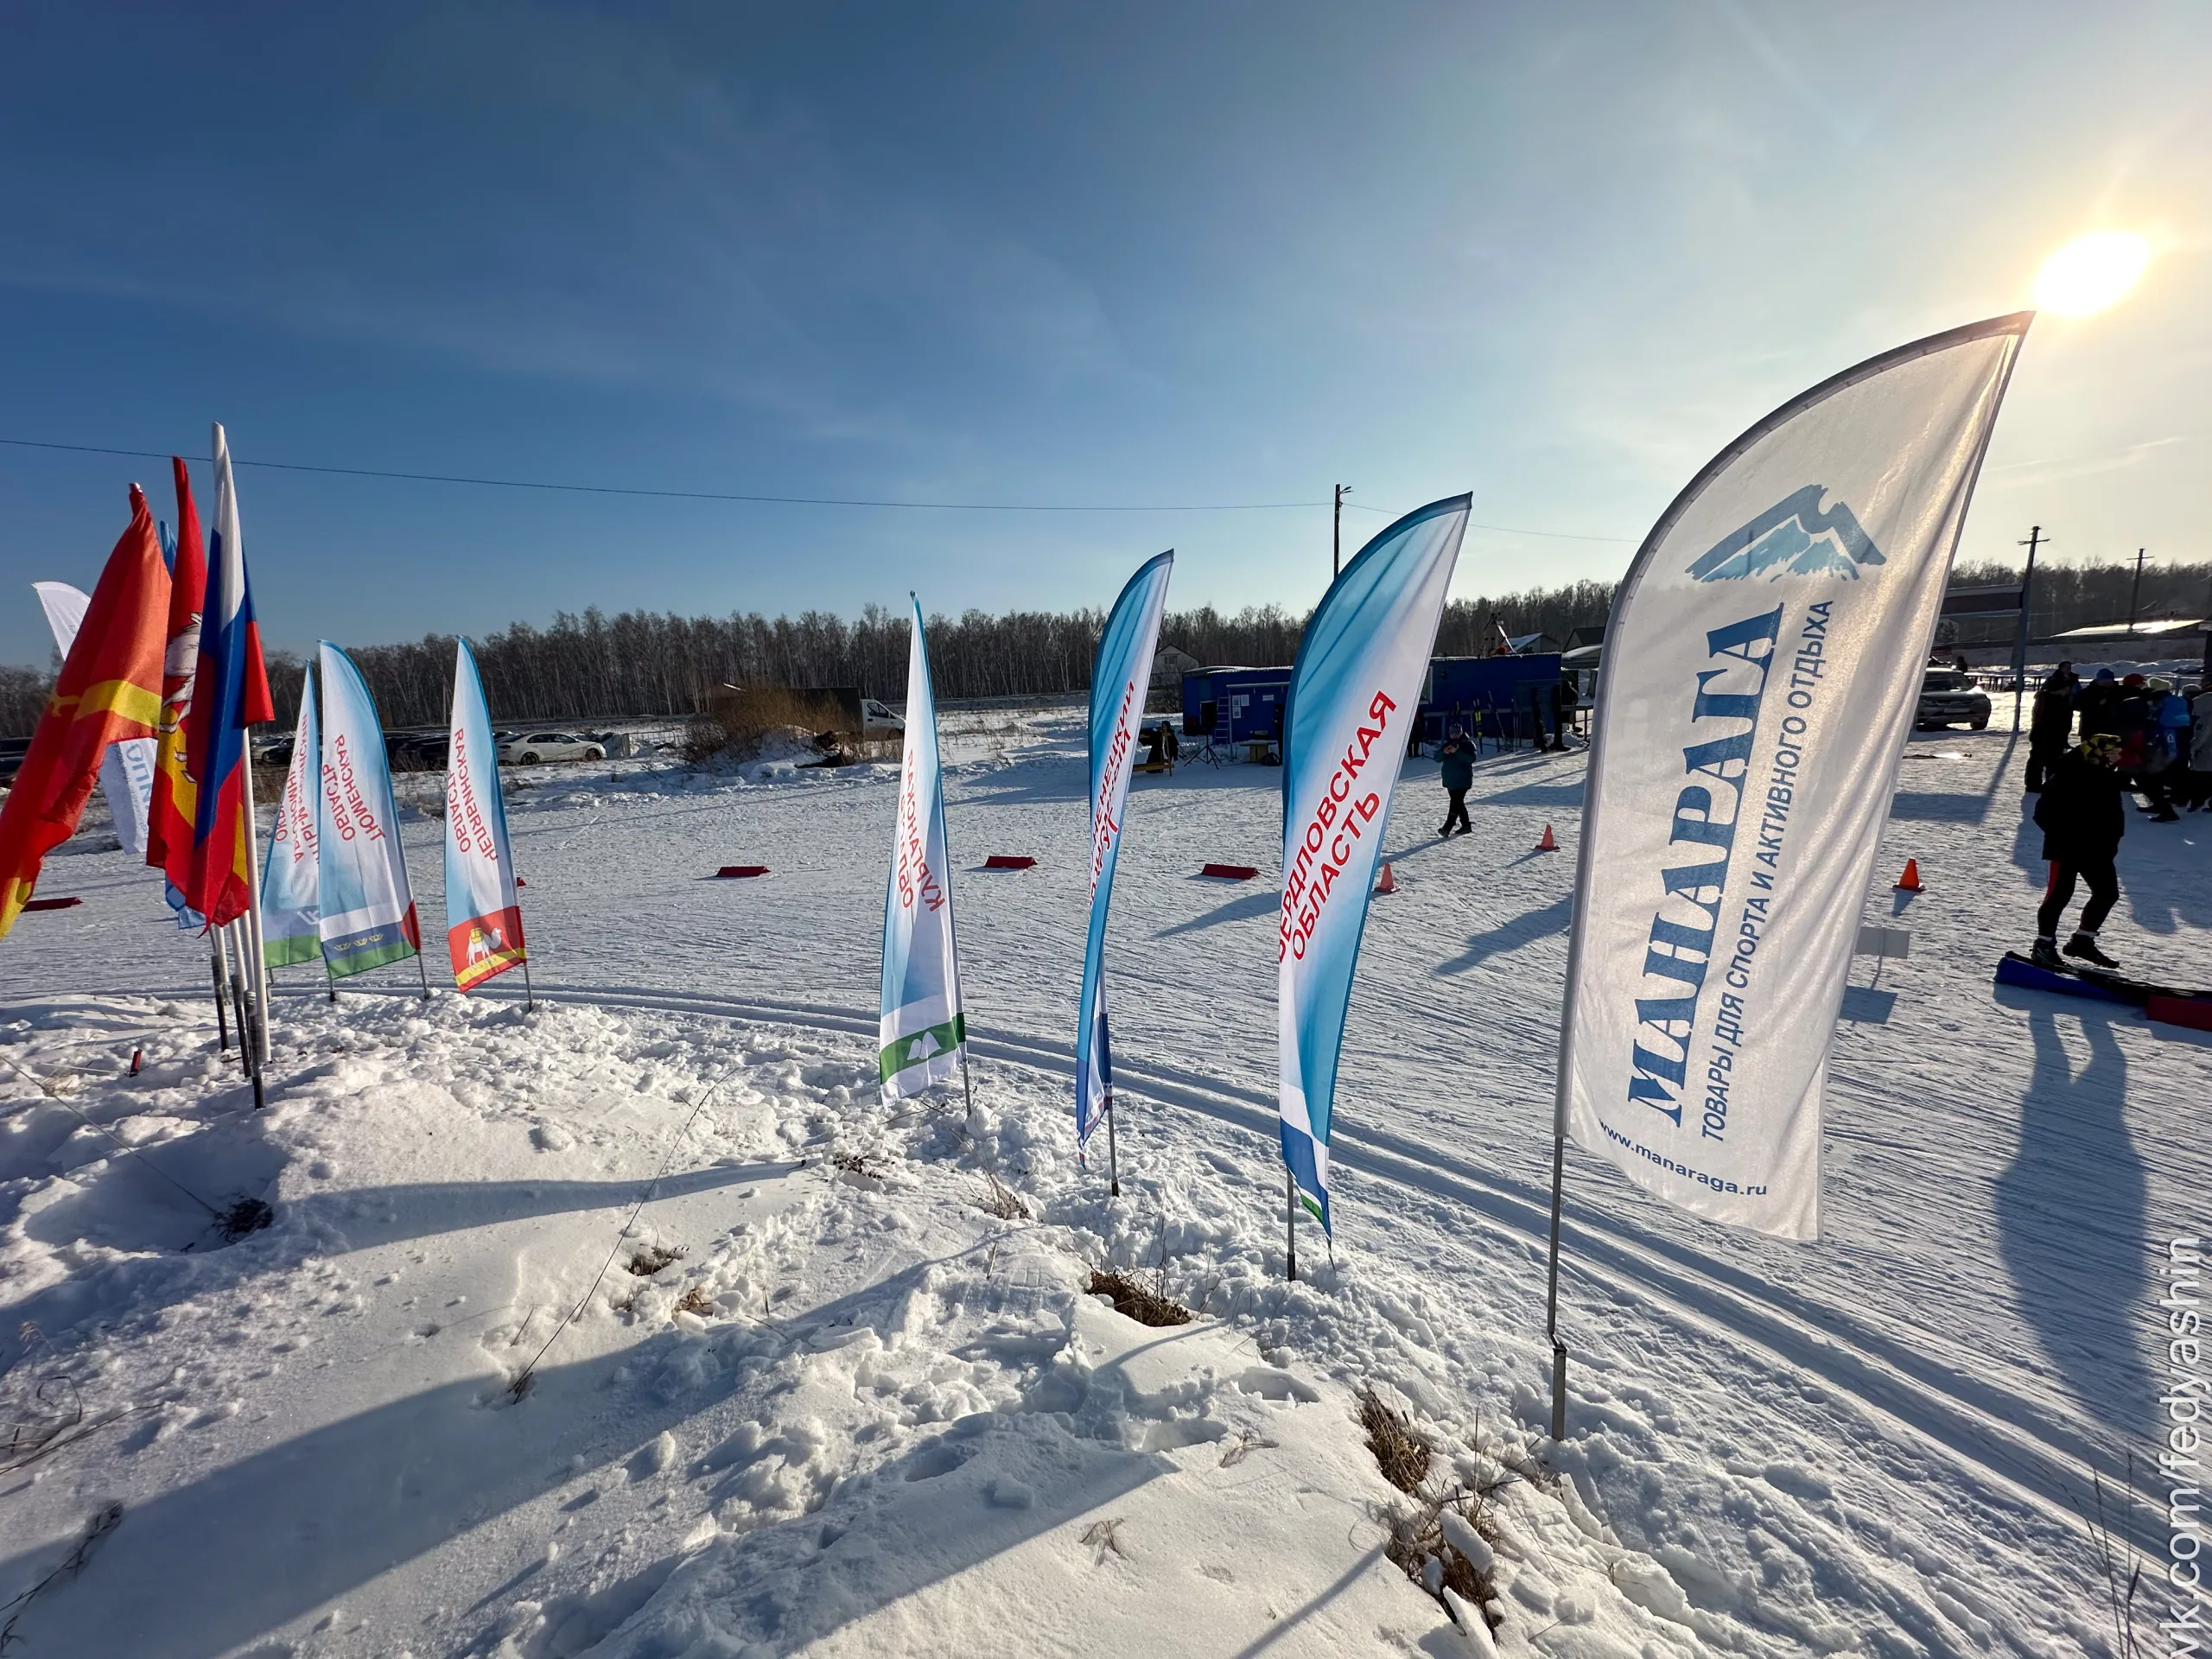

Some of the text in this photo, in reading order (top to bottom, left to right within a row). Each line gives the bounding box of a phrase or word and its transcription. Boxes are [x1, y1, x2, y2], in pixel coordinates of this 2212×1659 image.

[1279, 690, 1396, 963] ЕРДЛОВСКАЯ
[1293, 792, 1381, 961] ОБЛАСТЬ
[1628, 601, 1784, 1128] МАНАРАГА
[1701, 601, 1834, 1141] ТОВАРЫ ДЛЯ СПОРТА И АКТИВНОГО ОТДЫХА
